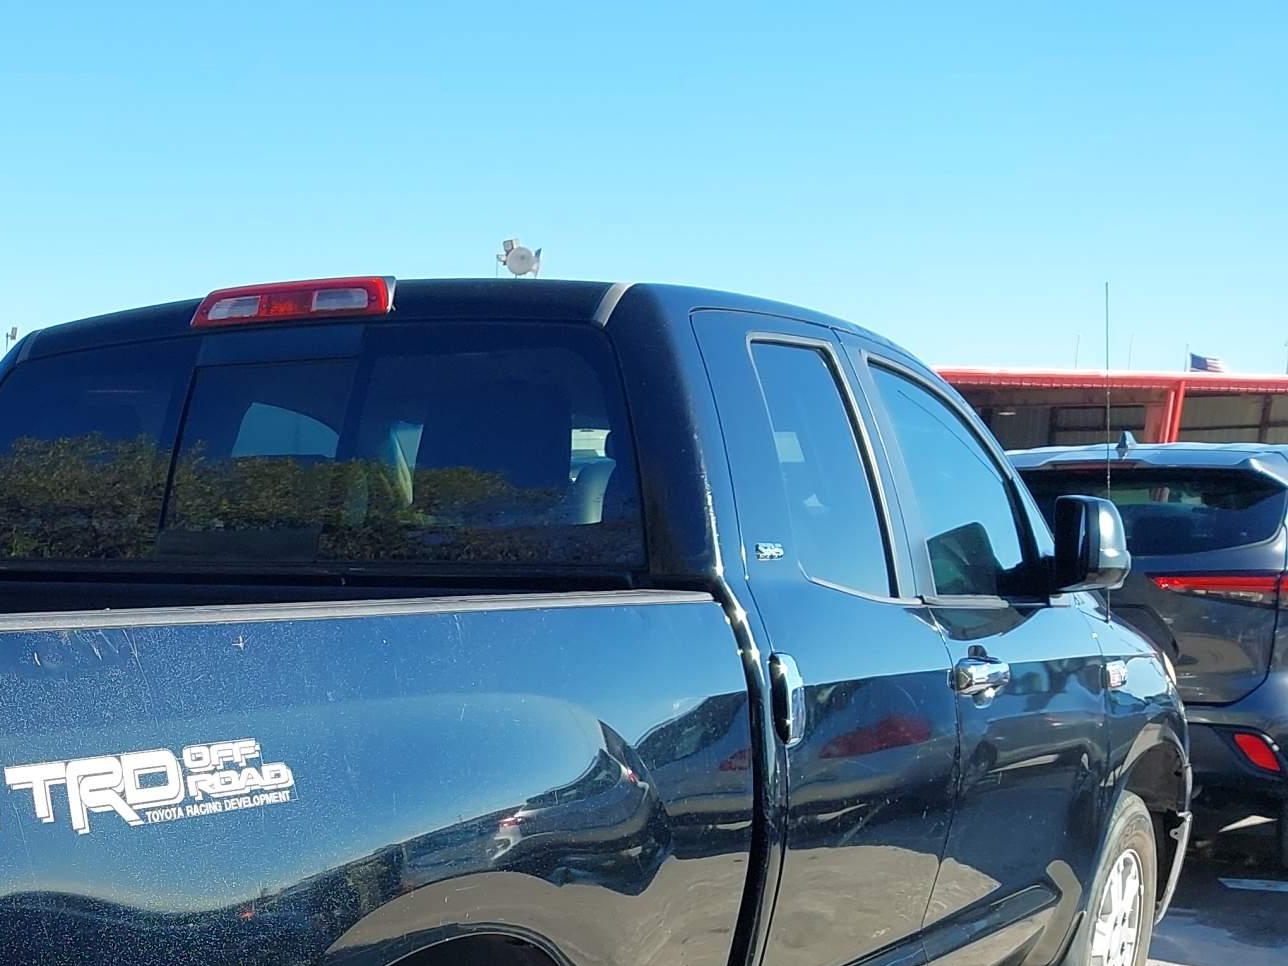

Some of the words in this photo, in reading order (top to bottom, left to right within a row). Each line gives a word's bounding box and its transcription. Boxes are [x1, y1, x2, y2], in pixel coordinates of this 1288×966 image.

[183, 738, 261, 773] OFF
[4, 747, 186, 835] TRD
[187, 762, 295, 799] ROAD
[146, 806, 184, 823] TOYOTA
[187, 799, 223, 817] RACING
[225, 790, 291, 811] DEVELOPMENT
